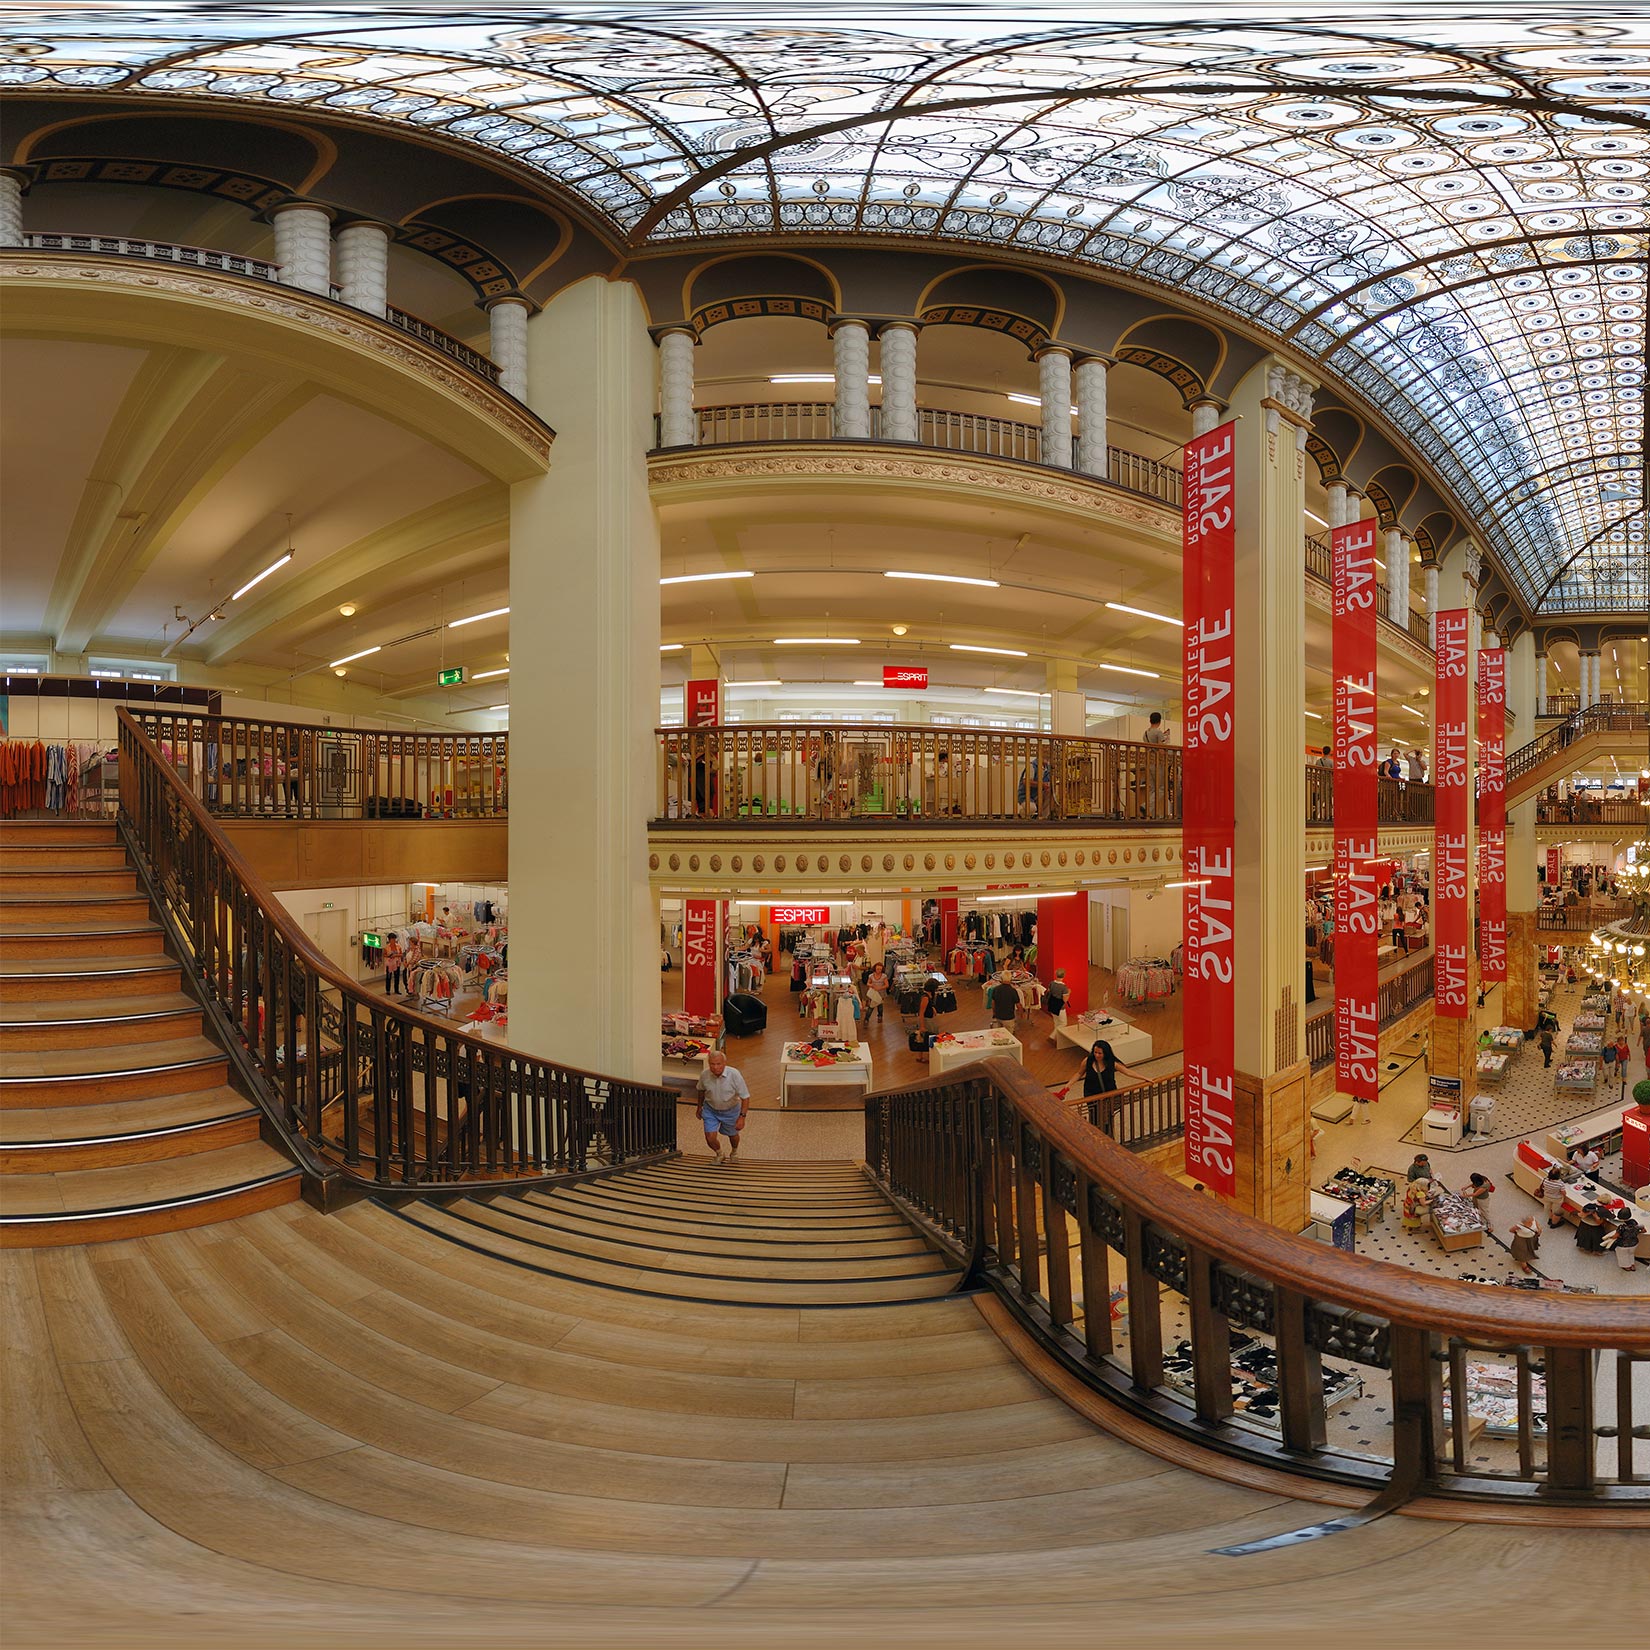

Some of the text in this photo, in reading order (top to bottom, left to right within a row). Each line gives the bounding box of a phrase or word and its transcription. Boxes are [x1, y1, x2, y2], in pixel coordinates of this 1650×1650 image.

[898, 672, 928, 681] ESPRIT
[698, 691, 715, 726] ALE
[775, 909, 825, 922] ESPRIT
[687, 909, 706, 966] SALE
[706, 910, 714, 966] REDUZIERT
[1626, 1116, 1647, 1131] Kasse
